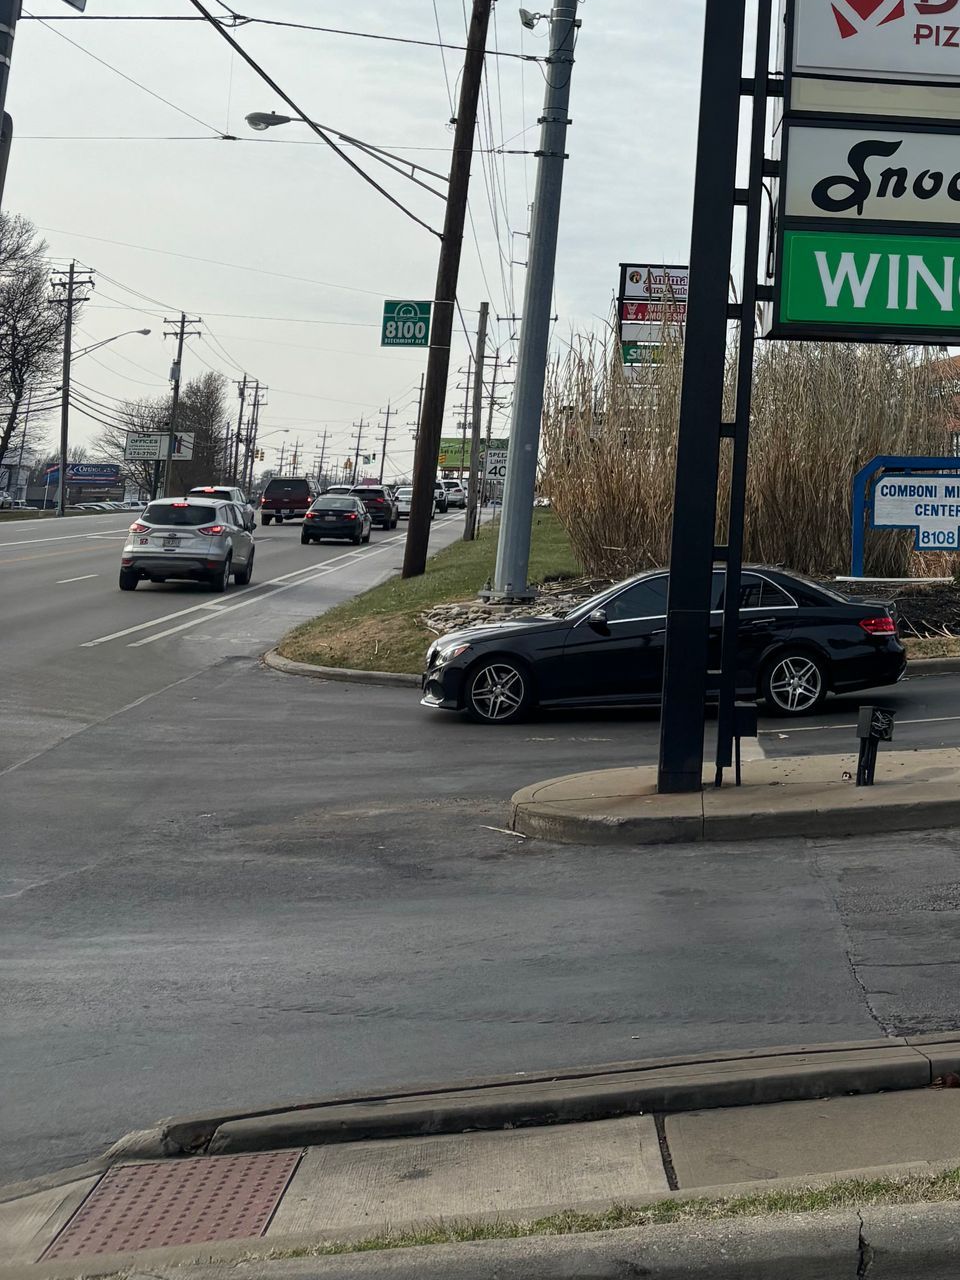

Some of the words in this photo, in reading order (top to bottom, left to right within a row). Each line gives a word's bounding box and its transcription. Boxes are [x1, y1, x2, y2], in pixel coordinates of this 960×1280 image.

[644, 272, 688, 286] Anima
[385, 321, 426, 338] 8100
[880, 484, 937, 499] COMBONI
[921, 531, 955, 544] 8108
